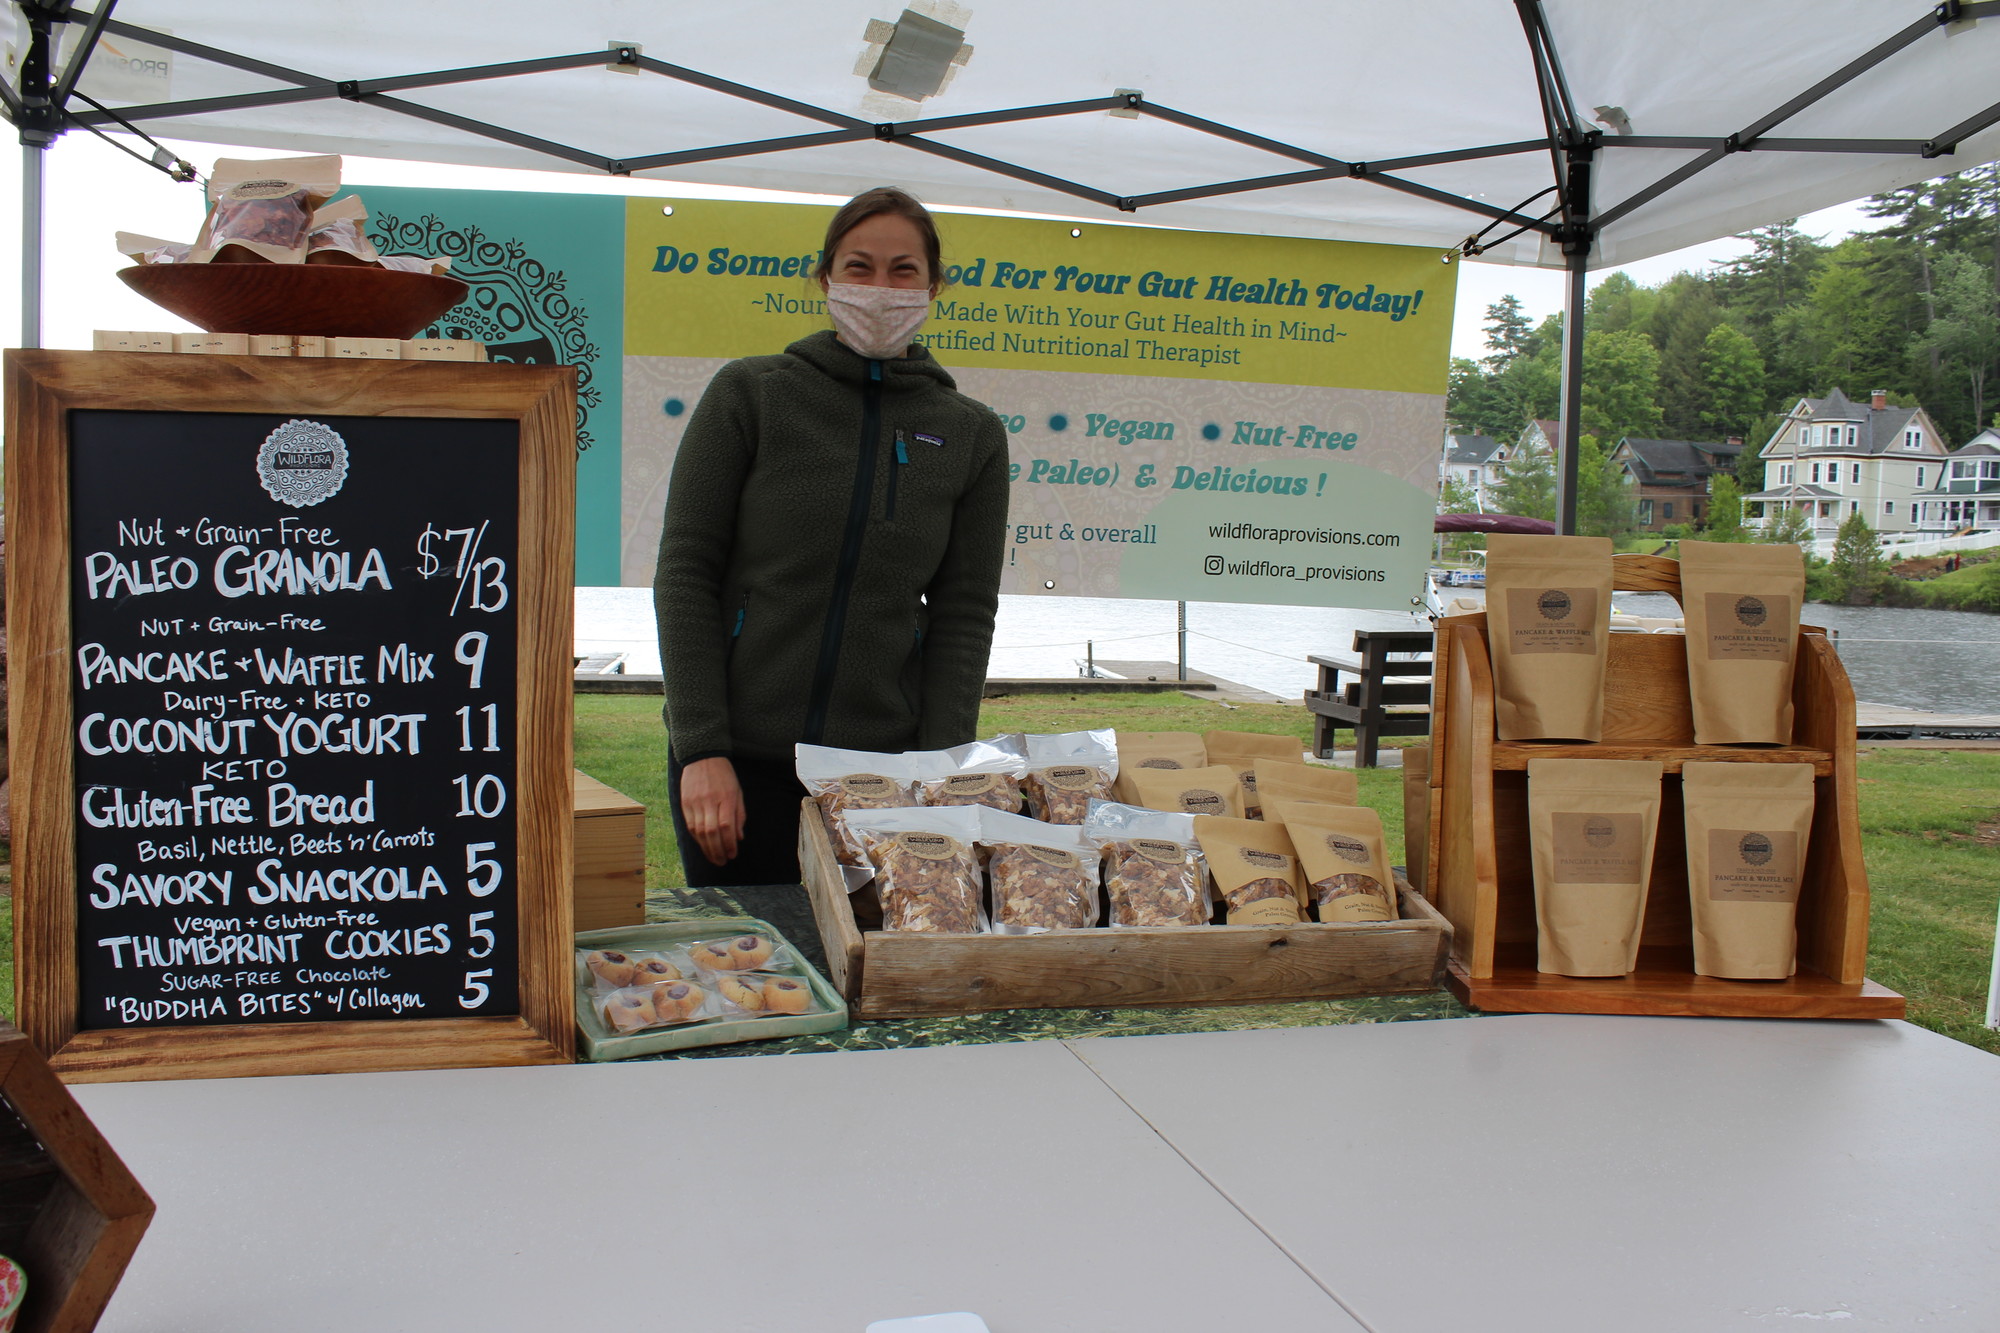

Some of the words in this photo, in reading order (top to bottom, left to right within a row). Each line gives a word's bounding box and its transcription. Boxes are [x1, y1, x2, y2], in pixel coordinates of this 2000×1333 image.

[651, 245, 699, 274] Do
[707, 248, 825, 279] Somet
[990, 261, 1046, 291] For
[1054, 264, 1131, 296] Your
[1138, 270, 1199, 301] Gut
[1205, 275, 1308, 307] Health
[1315, 282, 1424, 322] Today!
[934, 300, 998, 323] Made
[1004, 304, 1060, 328] With
[1067, 307, 1119, 331] Your
[1126, 310, 1166, 334] Gut
[1173, 314, 1247, 338] Health
[1252, 317, 1272, 338] in
[1279, 321, 1348, 344] Mind~
[912, 329, 996, 352] ertified
[1003, 333, 1129, 360] Nutritional
[1136, 340, 1241, 368] Therapist
[1084, 412, 1175, 446] Vegan
[1230, 420, 1358, 452] Nut-Free
[278, 453, 332, 466] WILDFLORA
[1026, 458, 1120, 487] Paleo)
[1134, 464, 1157, 489] &
[1171, 465, 1308, 498] Delicious
[118, 518, 166, 547] Nut
[195, 517, 340, 547] Grain-Free
[1015, 522, 1053, 544] gut
[1059, 523, 1075, 541] &
[1082, 524, 1157, 544] overall
[1208, 522, 1401, 549] wildfloraprovisions.com
[85, 551, 199, 599] PALEO
[213, 545, 393, 598] GRANOLA
[1227, 559, 1386, 584] wildflora_provisions
[141, 618, 185, 637] NUT
[190, 620, 201, 632] +
[208, 613, 326, 634] Grain-Free
[78, 642, 229, 689] PANCAKE
[235, 655, 252, 673] +
[254, 647, 366, 686] WAFFLE
[454, 631, 489, 689] 9
[164, 690, 288, 720] Dairy-Free
[296, 696, 306, 707] +
[314, 690, 371, 710] KETO
[79, 712, 256, 757] COCONUT
[263, 711, 427, 758] YOGURT
[455, 703, 501, 753] 11
[202, 760, 287, 782] KETO
[81, 783, 253, 829] Gluten-Free
[268, 780, 375, 828] Bread
[452, 774, 507, 819] 10
[137, 835, 205, 863] Basil,
[211, 834, 285, 857] Nettle,
[289, 832, 342, 856] Beets
[371, 826, 435, 852] Carrots
[90, 863, 233, 909] SAVORY
[247, 858, 448, 905] SNACKOLA
[466, 841, 502, 898] 5
[98, 933, 303, 969] THUMBPRINT
[325, 922, 451, 960] COOKIES
[467, 910, 496, 959] 5
[246, 918, 259, 929] +
[264, 910, 380, 931] Gluten-Free
[160, 970, 282, 992] SUGAR-FREE
[296, 966, 392, 984] Chocolate
[458, 968, 493, 1010] 5
[327, 988, 345, 1013] w/
[349, 987, 426, 1015] Collagen
